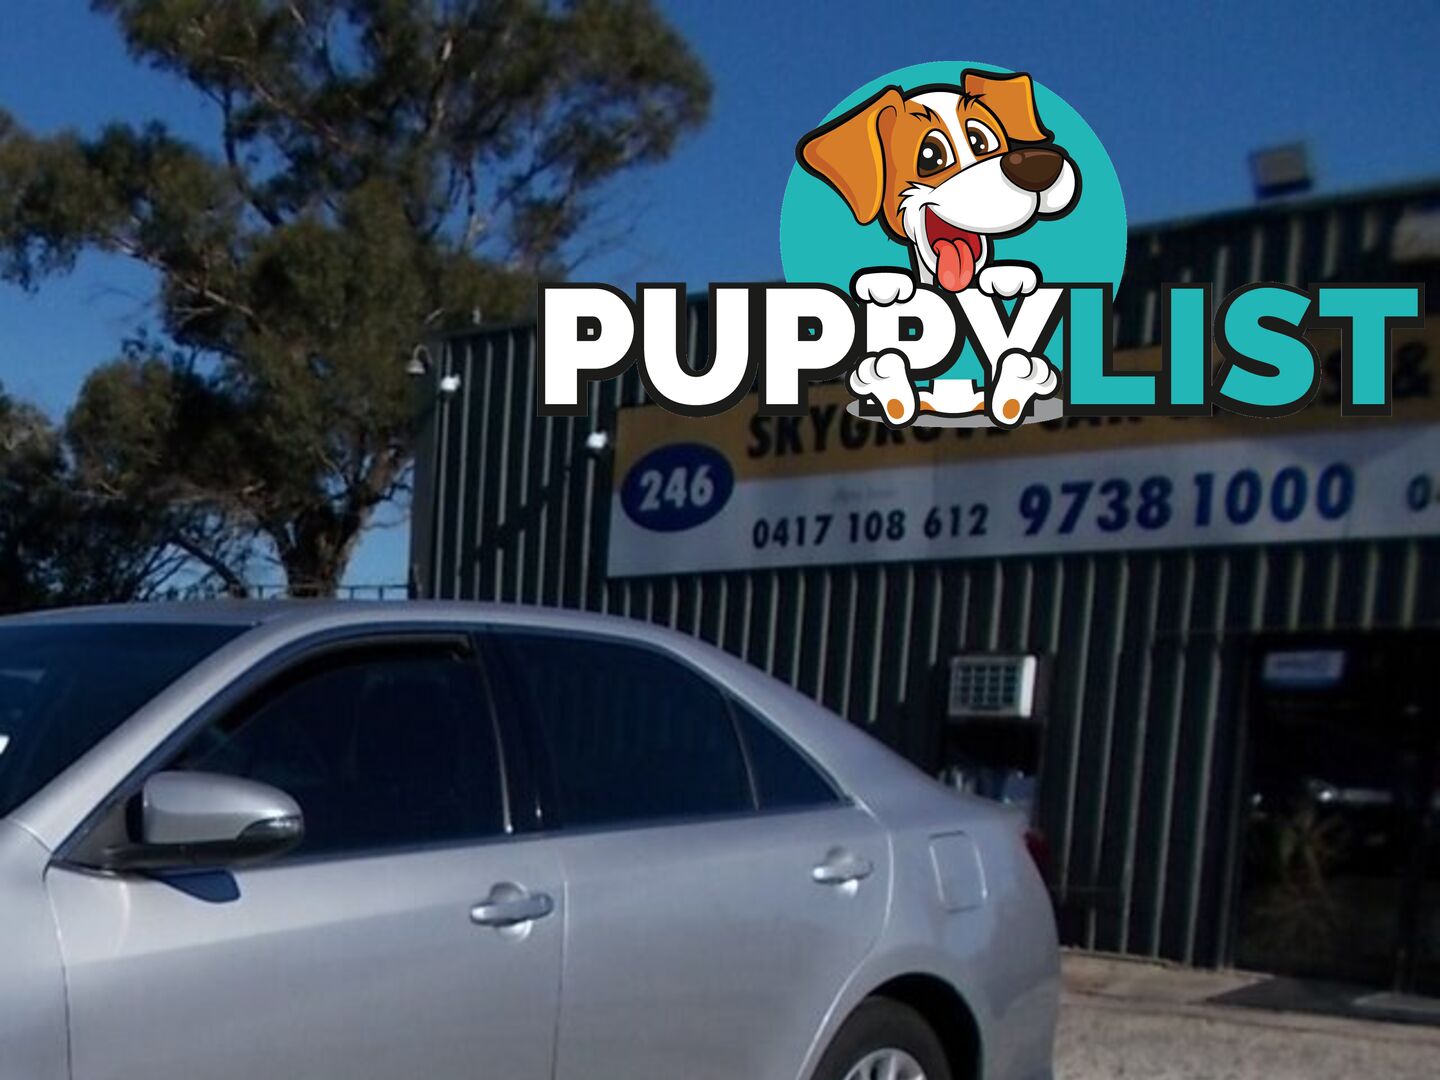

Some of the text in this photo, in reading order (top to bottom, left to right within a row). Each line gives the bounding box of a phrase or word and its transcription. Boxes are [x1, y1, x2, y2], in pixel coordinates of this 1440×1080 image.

[639, 464, 715, 512] 246
[751, 502, 990, 550] 0417 108 612
